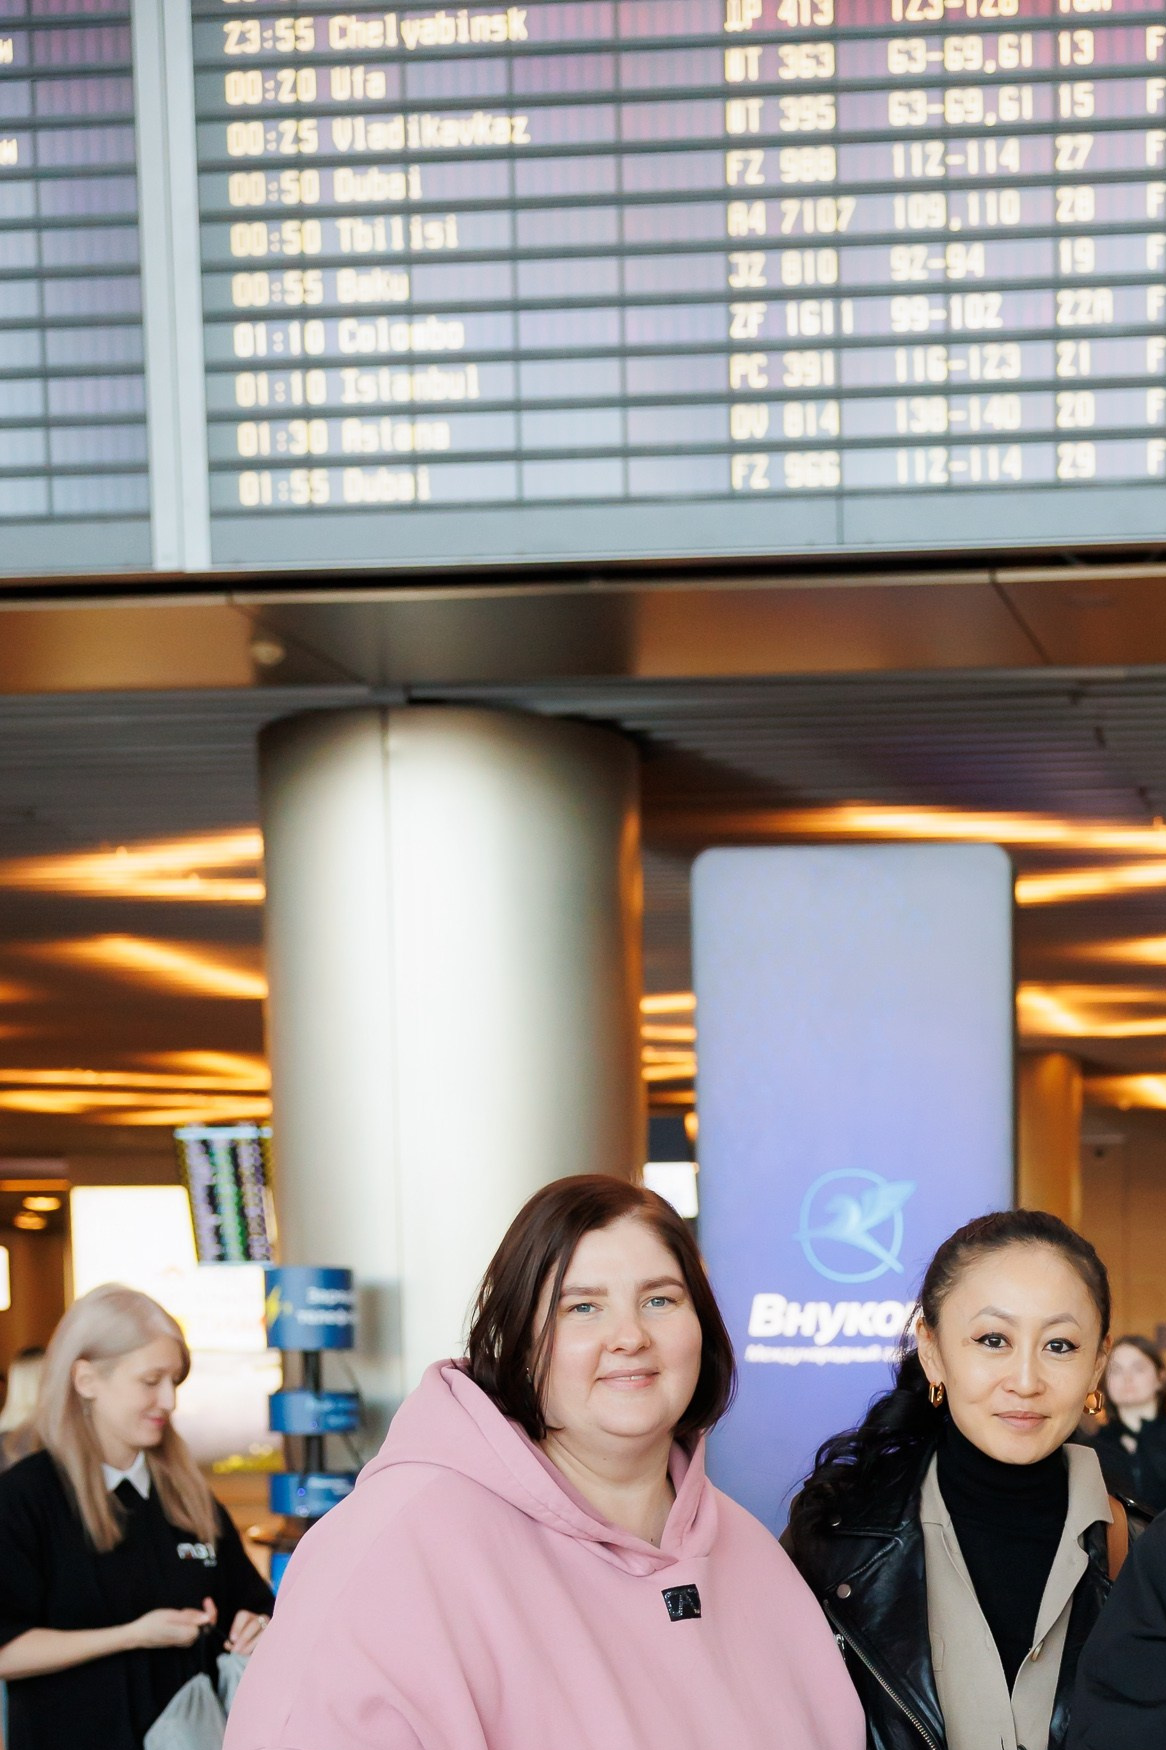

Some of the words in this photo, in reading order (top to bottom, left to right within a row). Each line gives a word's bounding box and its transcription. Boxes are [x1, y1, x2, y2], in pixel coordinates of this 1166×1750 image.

[223, 17, 315, 55] 23:55
[328, 7, 529, 50] Chelyabinsk
[225, 68, 317, 106] 00:20
[330, 65, 387, 101] Ufa
[724, 46, 763, 82] UT
[1058, 29, 1095, 66] 13
[226, 119, 319, 157] 00:25
[726, 98, 764, 134] UT
[779, 95, 836, 132] 395
[1058, 82, 1095, 119] 15
[228, 169, 321, 207] 00:50
[332, 165, 424, 203] Dubai
[726, 150, 766, 186] FZ
[891, 138, 1021, 179] 112-114
[1055, 134, 1094, 171] 27
[230, 219, 323, 257] 00:50
[333, 214, 461, 254] Tbilisi
[780, 197, 857, 235] 7107
[892, 189, 1021, 232] 109,110
[232, 270, 324, 307] 00:55
[335, 267, 410, 304] Baku
[728, 252, 768, 288] JZ
[890, 243, 986, 282] 92-94
[1059, 237, 1096, 274] 19
[233, 320, 326, 358] 01:10
[336, 315, 464, 354] Colombo
[785, 300, 855, 337] 1611
[890, 292, 1005, 333] 99-102
[235, 369, 327, 407] 01:10
[339, 364, 480, 404] Istanbul
[782, 351, 835, 388] 391
[1056, 341, 1091, 377] 21
[237, 419, 328, 457] 01:30
[341, 417, 450, 454] Astana
[1056, 391, 1096, 428] 20
[238, 468, 330, 506] 01:55
[343, 465, 430, 504] Dubai
[731, 454, 771, 490] FZ
[896, 444, 1021, 485] 112-114
[1057, 442, 1097, 479] 29
